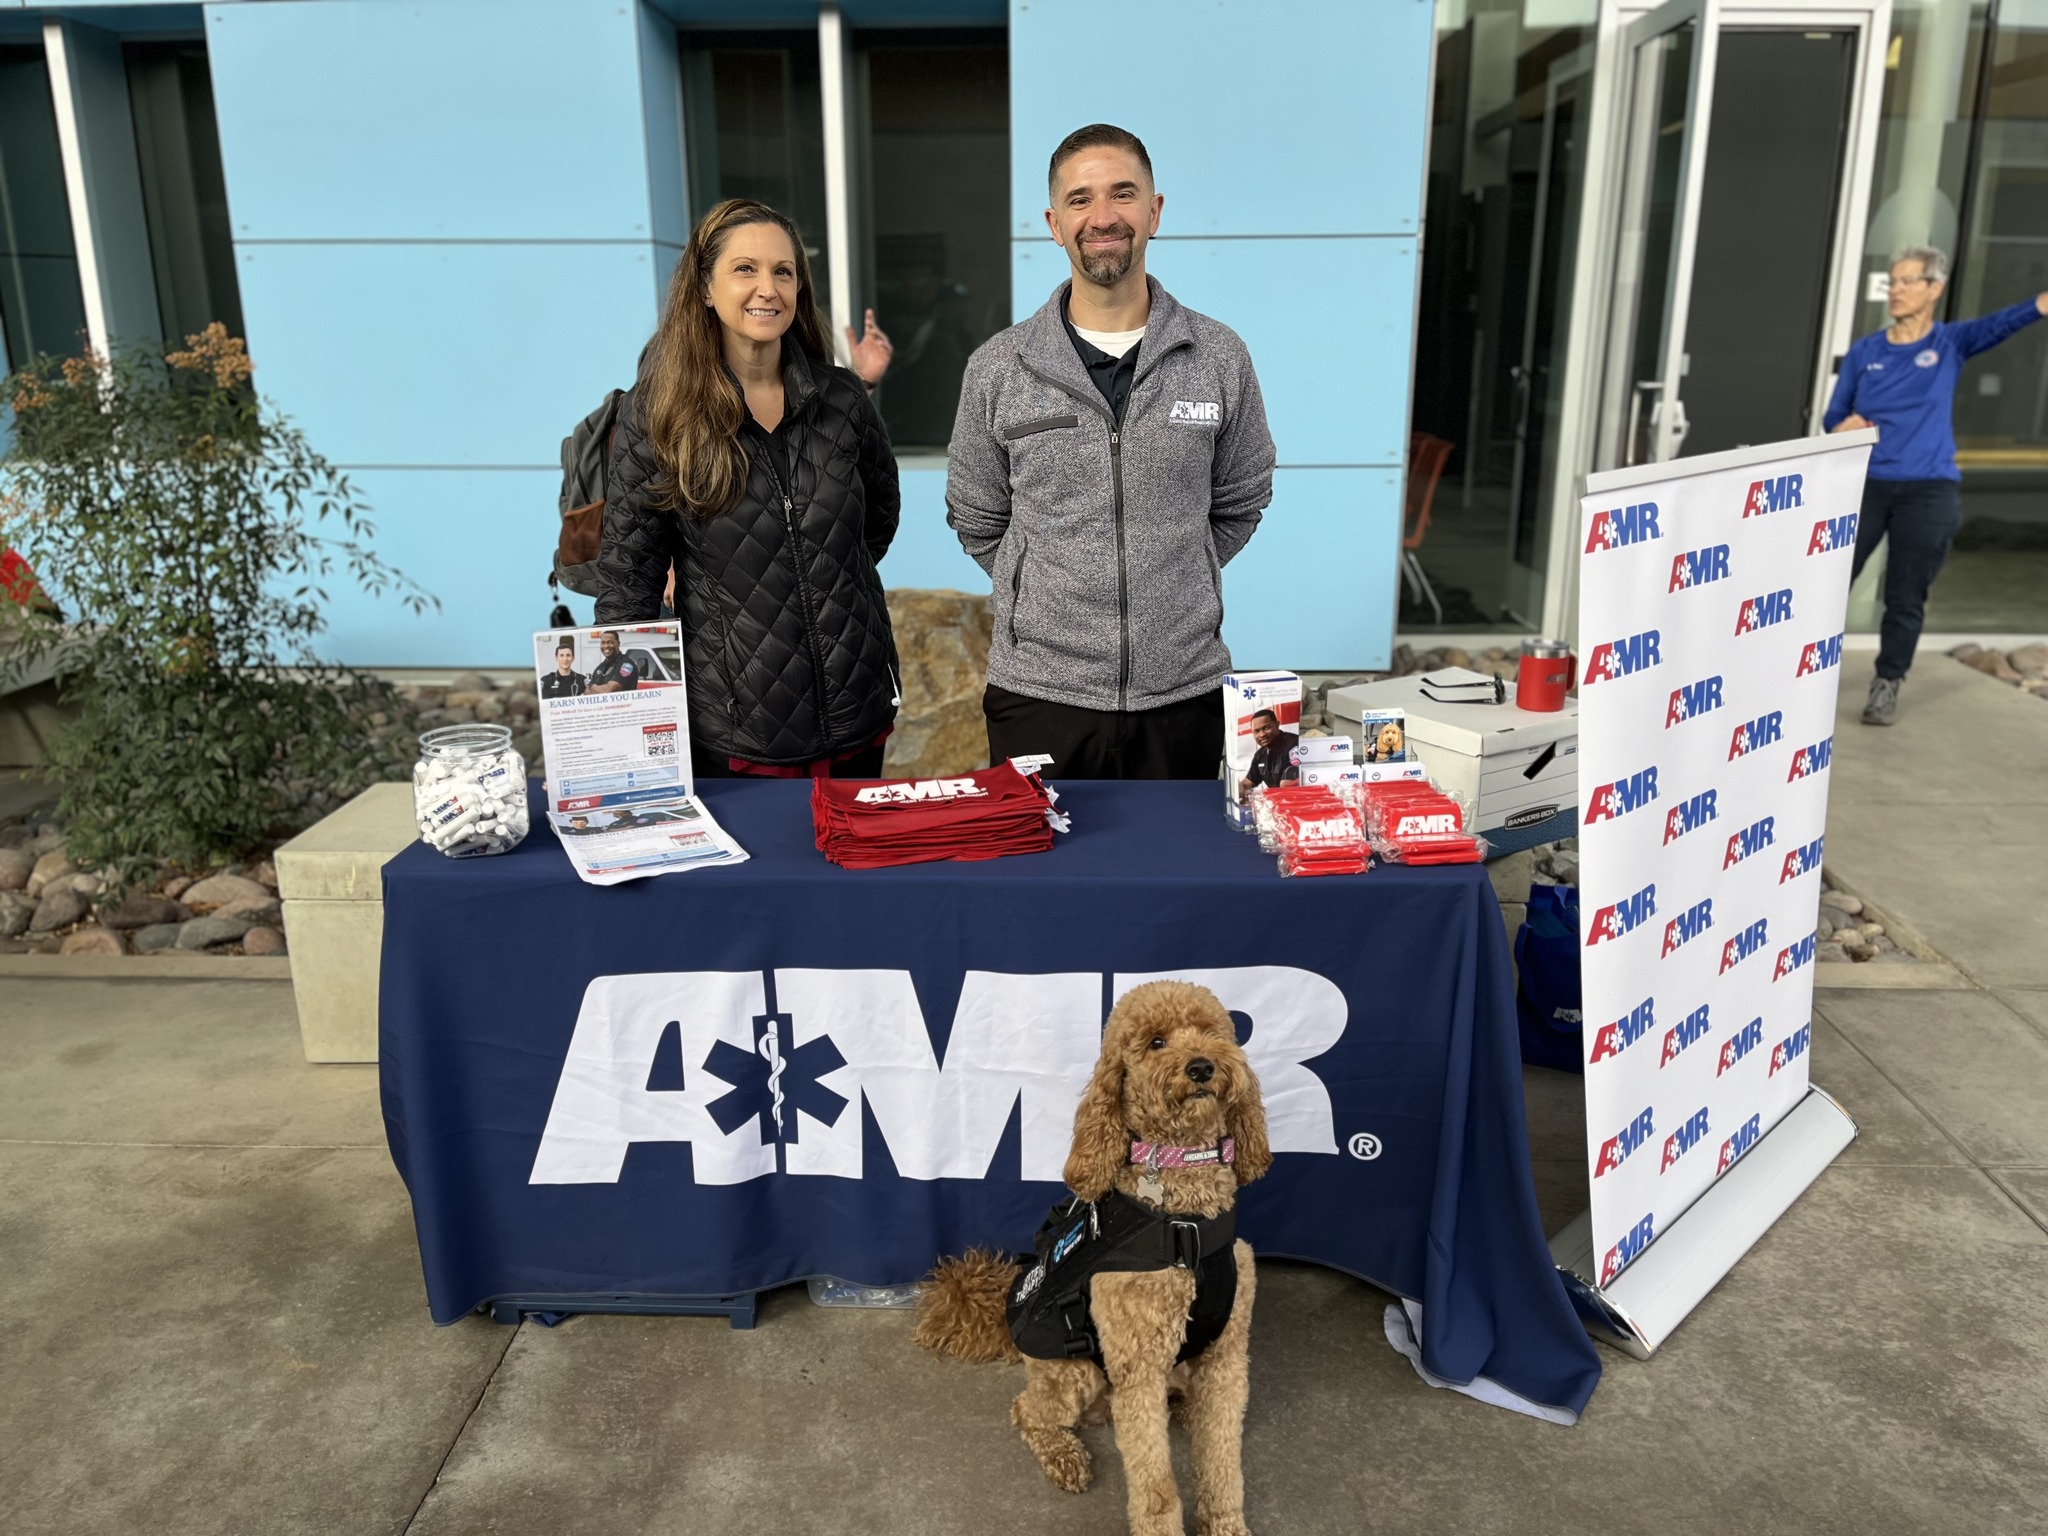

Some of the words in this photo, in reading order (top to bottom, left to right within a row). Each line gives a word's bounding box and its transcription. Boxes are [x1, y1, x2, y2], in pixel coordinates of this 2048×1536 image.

[1169, 401, 1220, 420] AMR
[1744, 475, 1802, 518] AMR
[1585, 502, 1659, 554] AMR
[1807, 513, 1858, 556] AMR
[1669, 544, 1730, 593] AMR
[1735, 588, 1793, 636] AMR
[1585, 630, 1661, 685] AMR
[550, 696, 575, 709] EARN
[577, 694, 608, 706] WHILE
[608, 692, 630, 703] YOU
[631, 690, 662, 700] LEARN
[1665, 675, 1723, 728] AMR
[1329, 743, 1350, 752] AMR
[1728, 710, 1782, 761] AMR
[854, 778, 981, 803] AMR
[1339, 772, 1359, 780] AMR
[1402, 769, 1422, 777] AMR
[1584, 766, 1658, 825] AMR
[567, 800, 590, 809] AMR
[1298, 817, 1356, 840] AMR
[1396, 814, 1457, 836] AMR
[1507, 812, 1540, 827] BANKERS
[1540, 808, 1555, 818] BOX
[1663, 788, 1717, 845] AMR
[1723, 816, 1774, 870] AMR
[1587, 884, 1655, 946] AMR
[1661, 898, 1712, 959] AMR
[1719, 918, 1767, 975] AMR
[1590, 997, 1654, 1063] AMR
[1660, 1004, 1709, 1068] AMR
[1717, 1016, 1762, 1077] AMR
[1594, 1107, 1653, 1178] AMR
[1661, 1107, 1708, 1175] AMR
[1716, 1113, 1760, 1176] AMR
[1600, 1213, 1653, 1288] AMR
